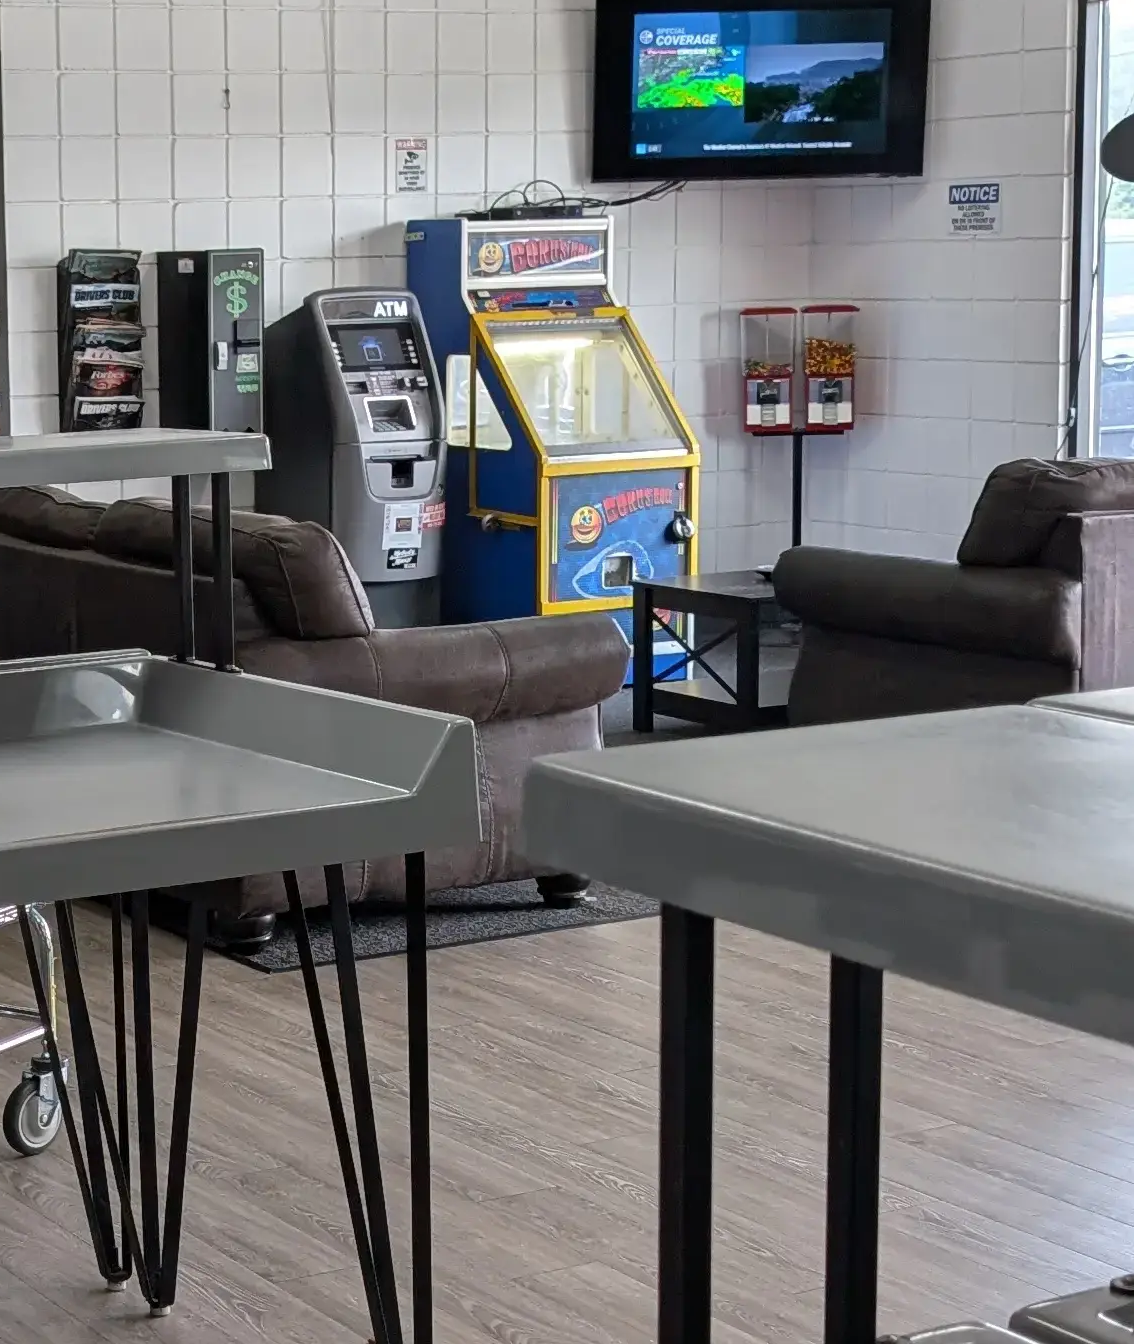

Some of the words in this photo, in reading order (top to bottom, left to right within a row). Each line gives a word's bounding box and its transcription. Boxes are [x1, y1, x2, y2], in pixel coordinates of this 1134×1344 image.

[656, 27, 685, 35] SPECIAL
[655, 33, 719, 46] COVERAGE
[950, 186, 998, 202] NOTICE
[509, 239, 569, 273] BONUS
[213, 269, 260, 286] CHANGE
[74, 289, 110, 302] DRIVERS
[112, 289, 135, 301] CLUB
[226, 281, 248, 318] $
[373, 300, 408, 317] ATM
[91, 370, 124, 379] Forbes
[80, 403, 117, 415] DRIVERS
[119, 403, 141, 414] CLUB
[602, 488, 653, 524] BONUS
